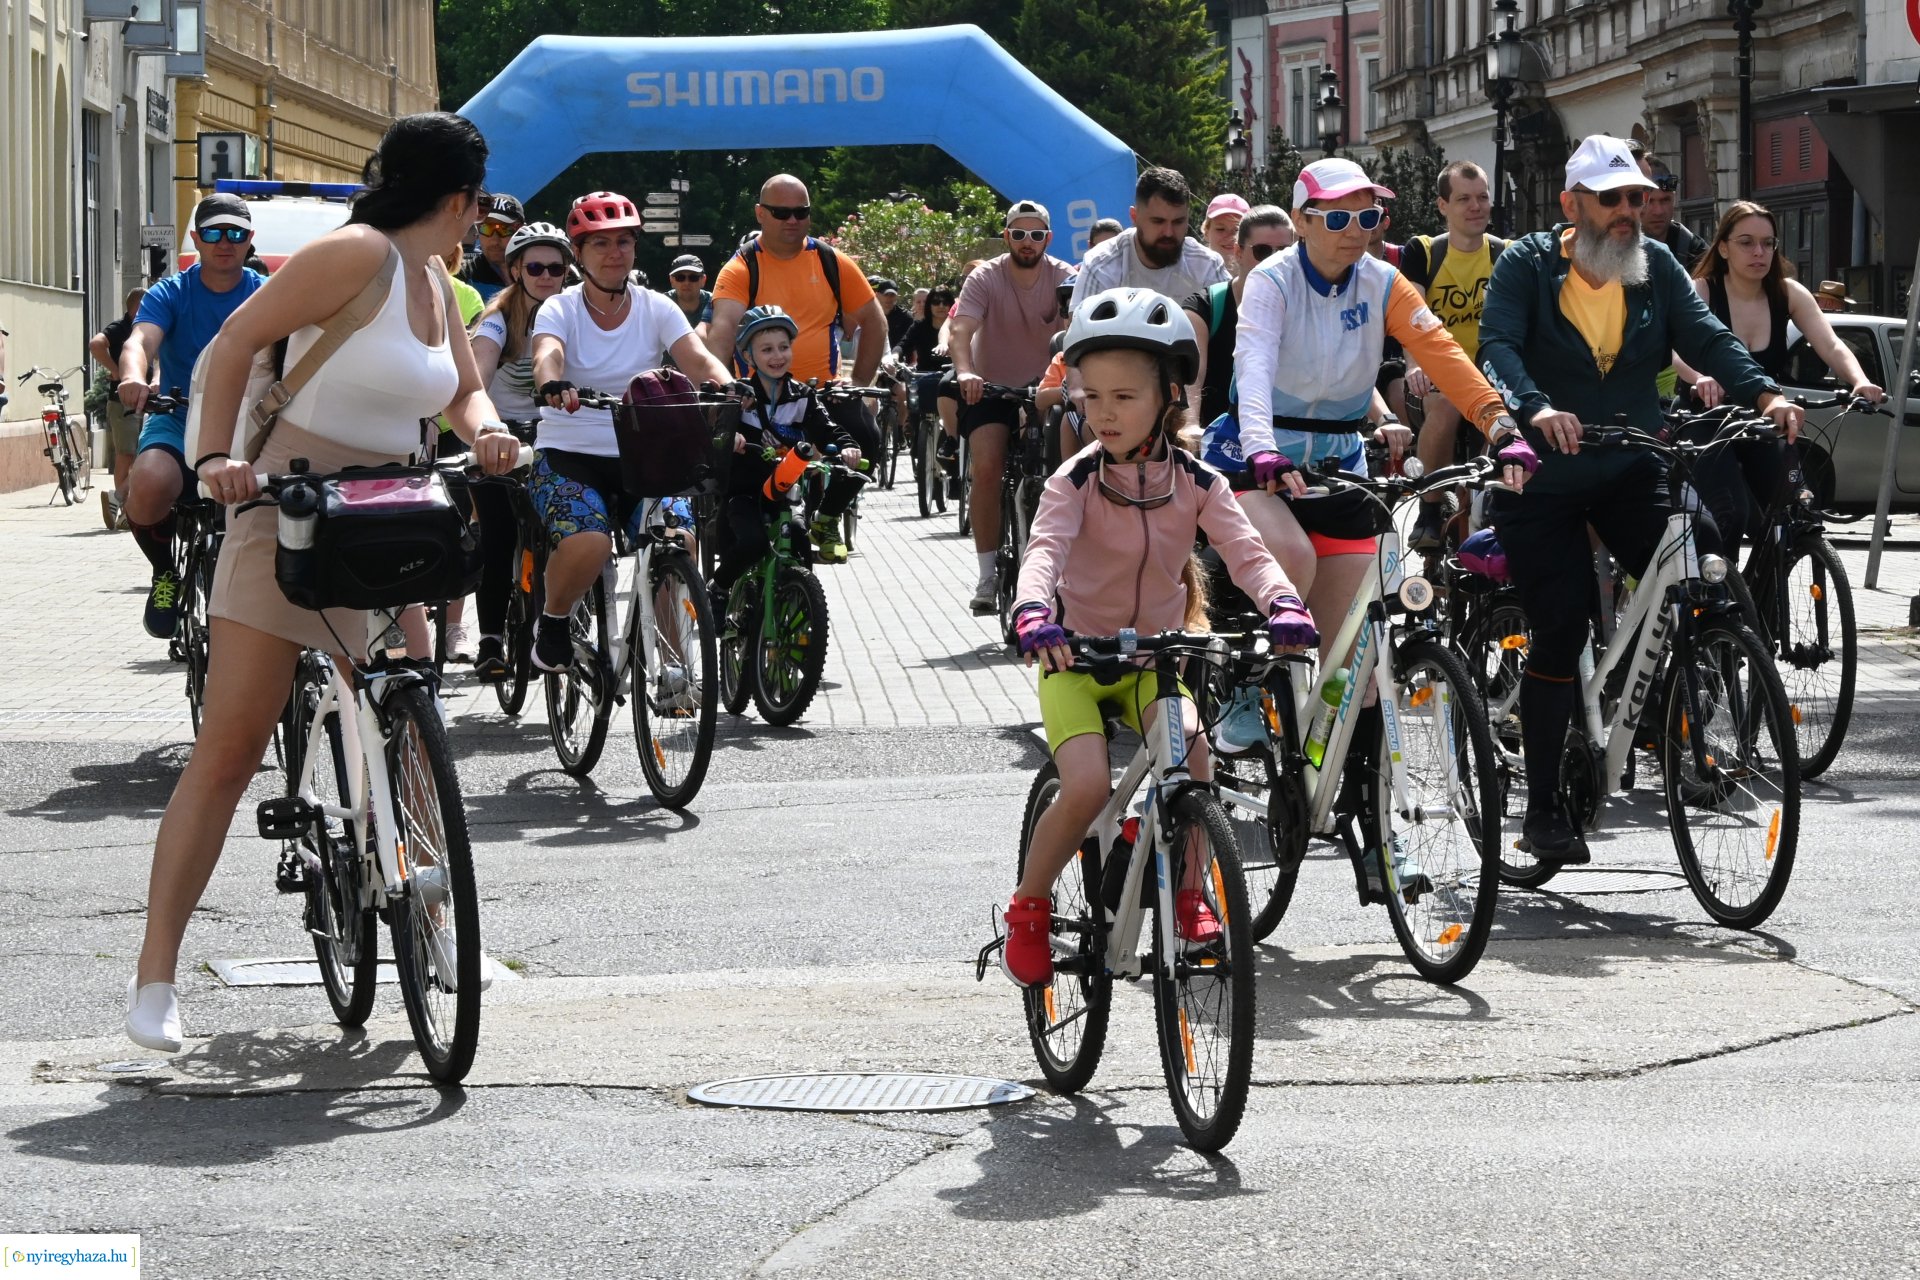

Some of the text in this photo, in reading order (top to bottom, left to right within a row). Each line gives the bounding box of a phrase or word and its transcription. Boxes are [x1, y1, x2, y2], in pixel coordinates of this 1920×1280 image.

[626, 66, 885, 108] SHIMANO
[400, 558, 425, 573] KLS
[1168, 698, 1184, 766] GIANT
